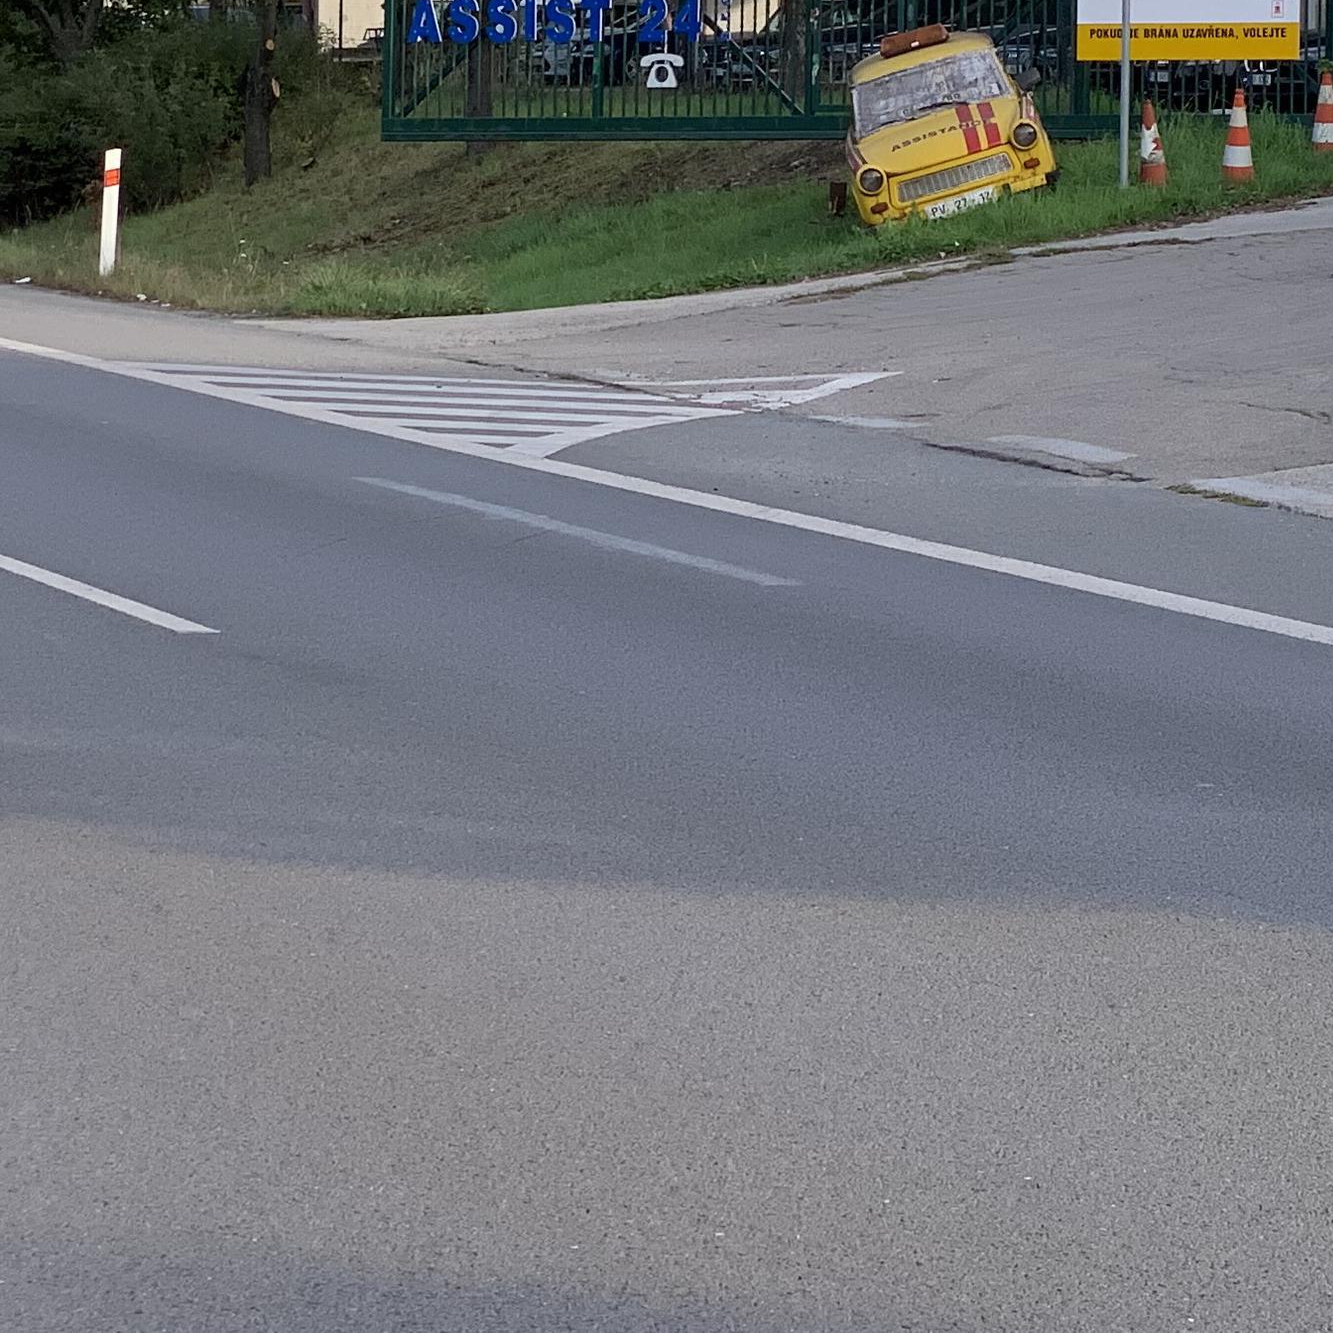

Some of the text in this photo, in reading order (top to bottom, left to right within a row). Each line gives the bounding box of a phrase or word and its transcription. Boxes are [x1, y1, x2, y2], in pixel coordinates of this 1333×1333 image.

[1143, 25, 1178, 39] BRÁNA
[1182, 25, 1239, 40] UZAVŘENA,
[1243, 27, 1287, 38] VOLEJTE
[931, 205, 945, 217] PV
